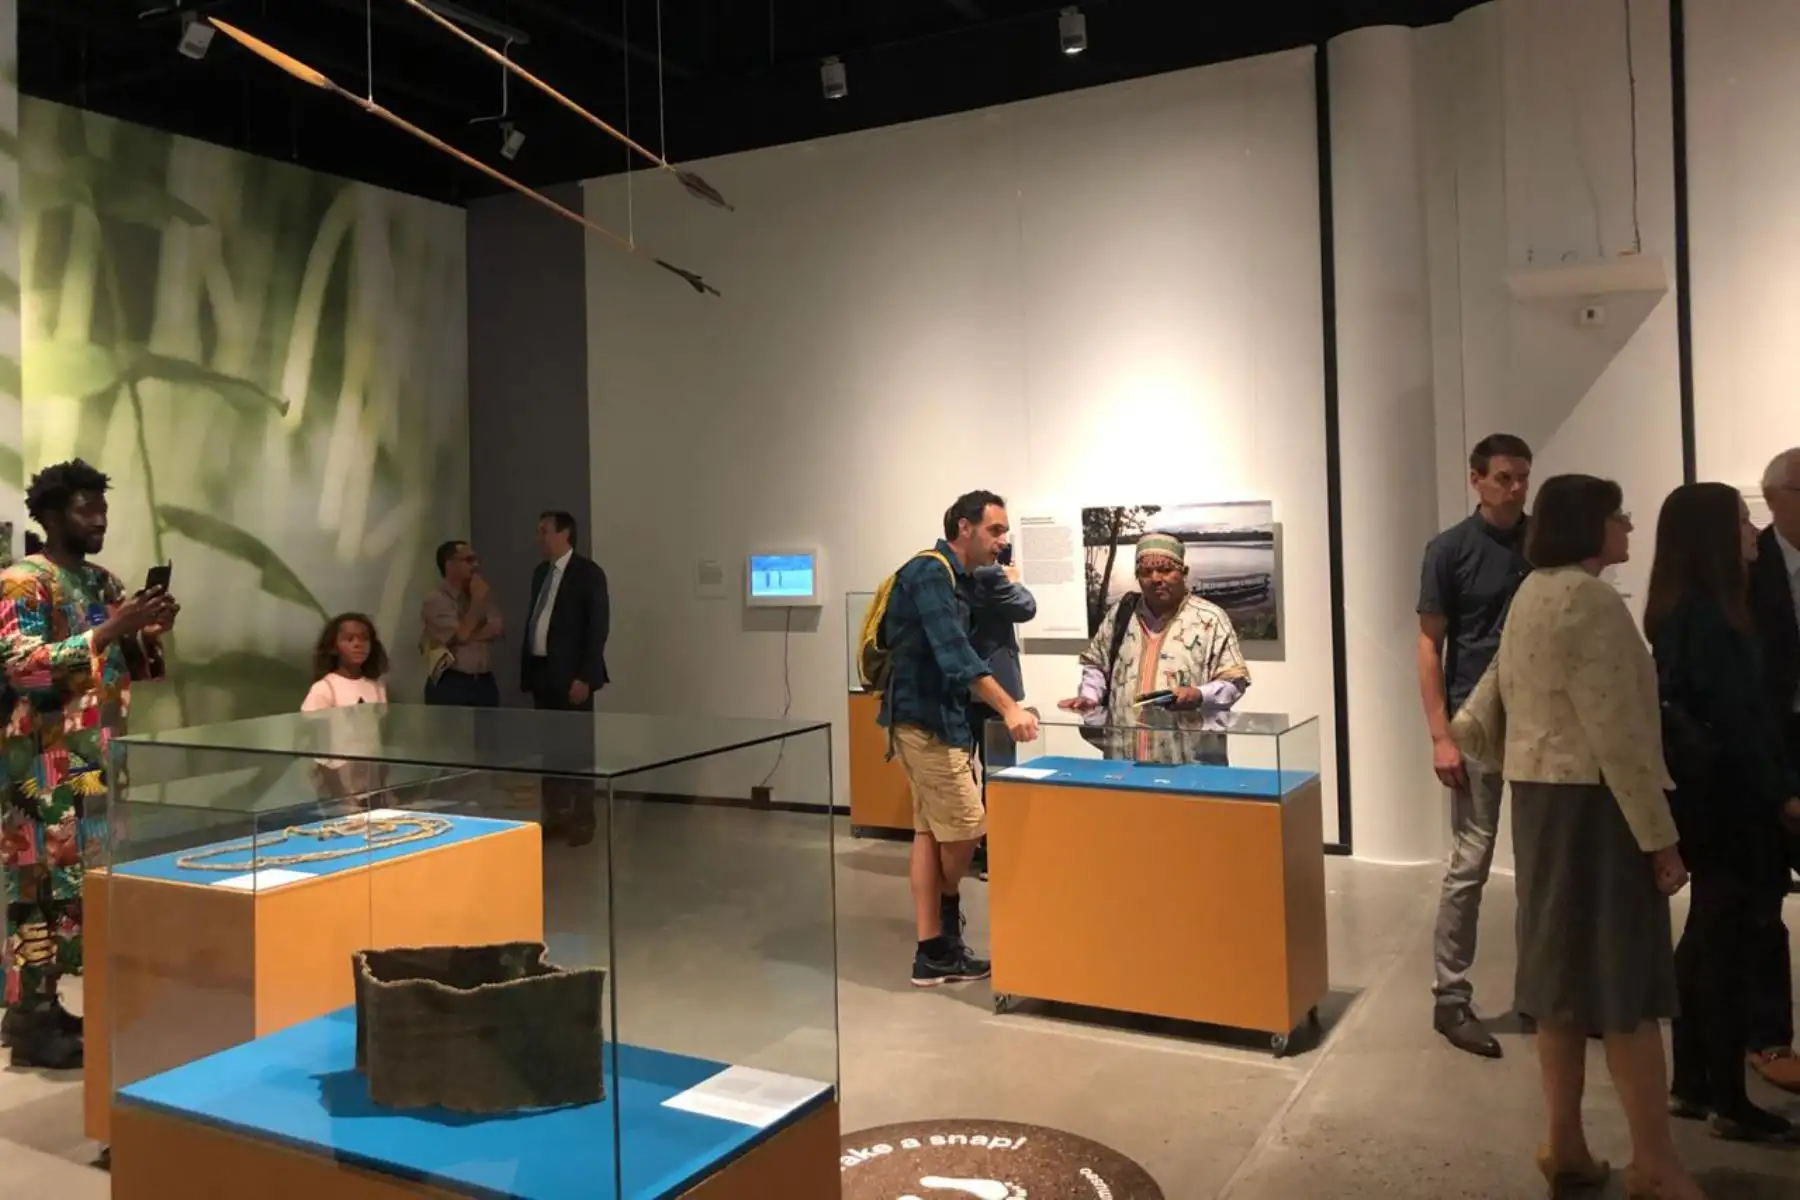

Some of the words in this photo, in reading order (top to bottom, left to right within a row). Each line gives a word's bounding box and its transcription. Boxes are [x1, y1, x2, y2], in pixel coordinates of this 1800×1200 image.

[840, 1143, 893, 1172] ake
[900, 1138, 921, 1150] a
[929, 1134, 1028, 1151] snap!
